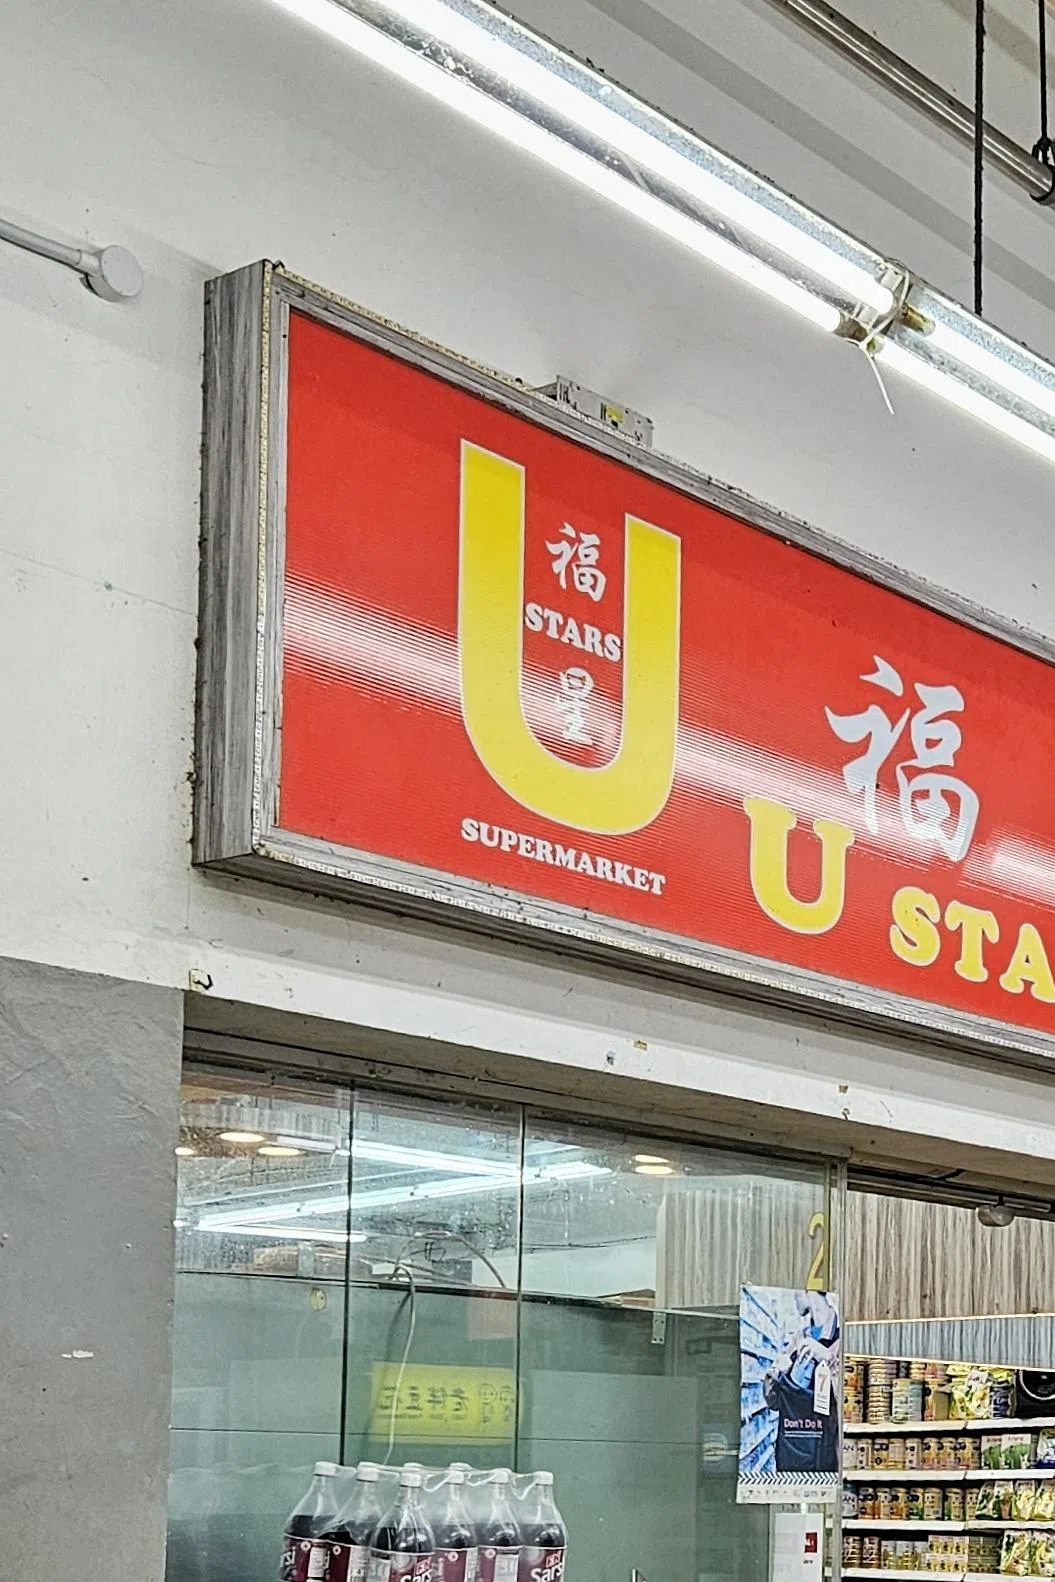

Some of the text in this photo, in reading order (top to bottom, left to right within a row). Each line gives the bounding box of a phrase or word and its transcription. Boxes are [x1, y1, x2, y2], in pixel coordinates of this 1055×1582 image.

[545, 521, 608, 603] 福
[459, 438, 681, 836] U
[525, 605, 624, 663] STARS
[555, 667, 595, 745] 星
[460, 817, 669, 896] SUPERMARKET
[743, 796, 855, 935] U
[783, 1417, 804, 1428] Don't
[805, 1418, 817, 1428] Do
